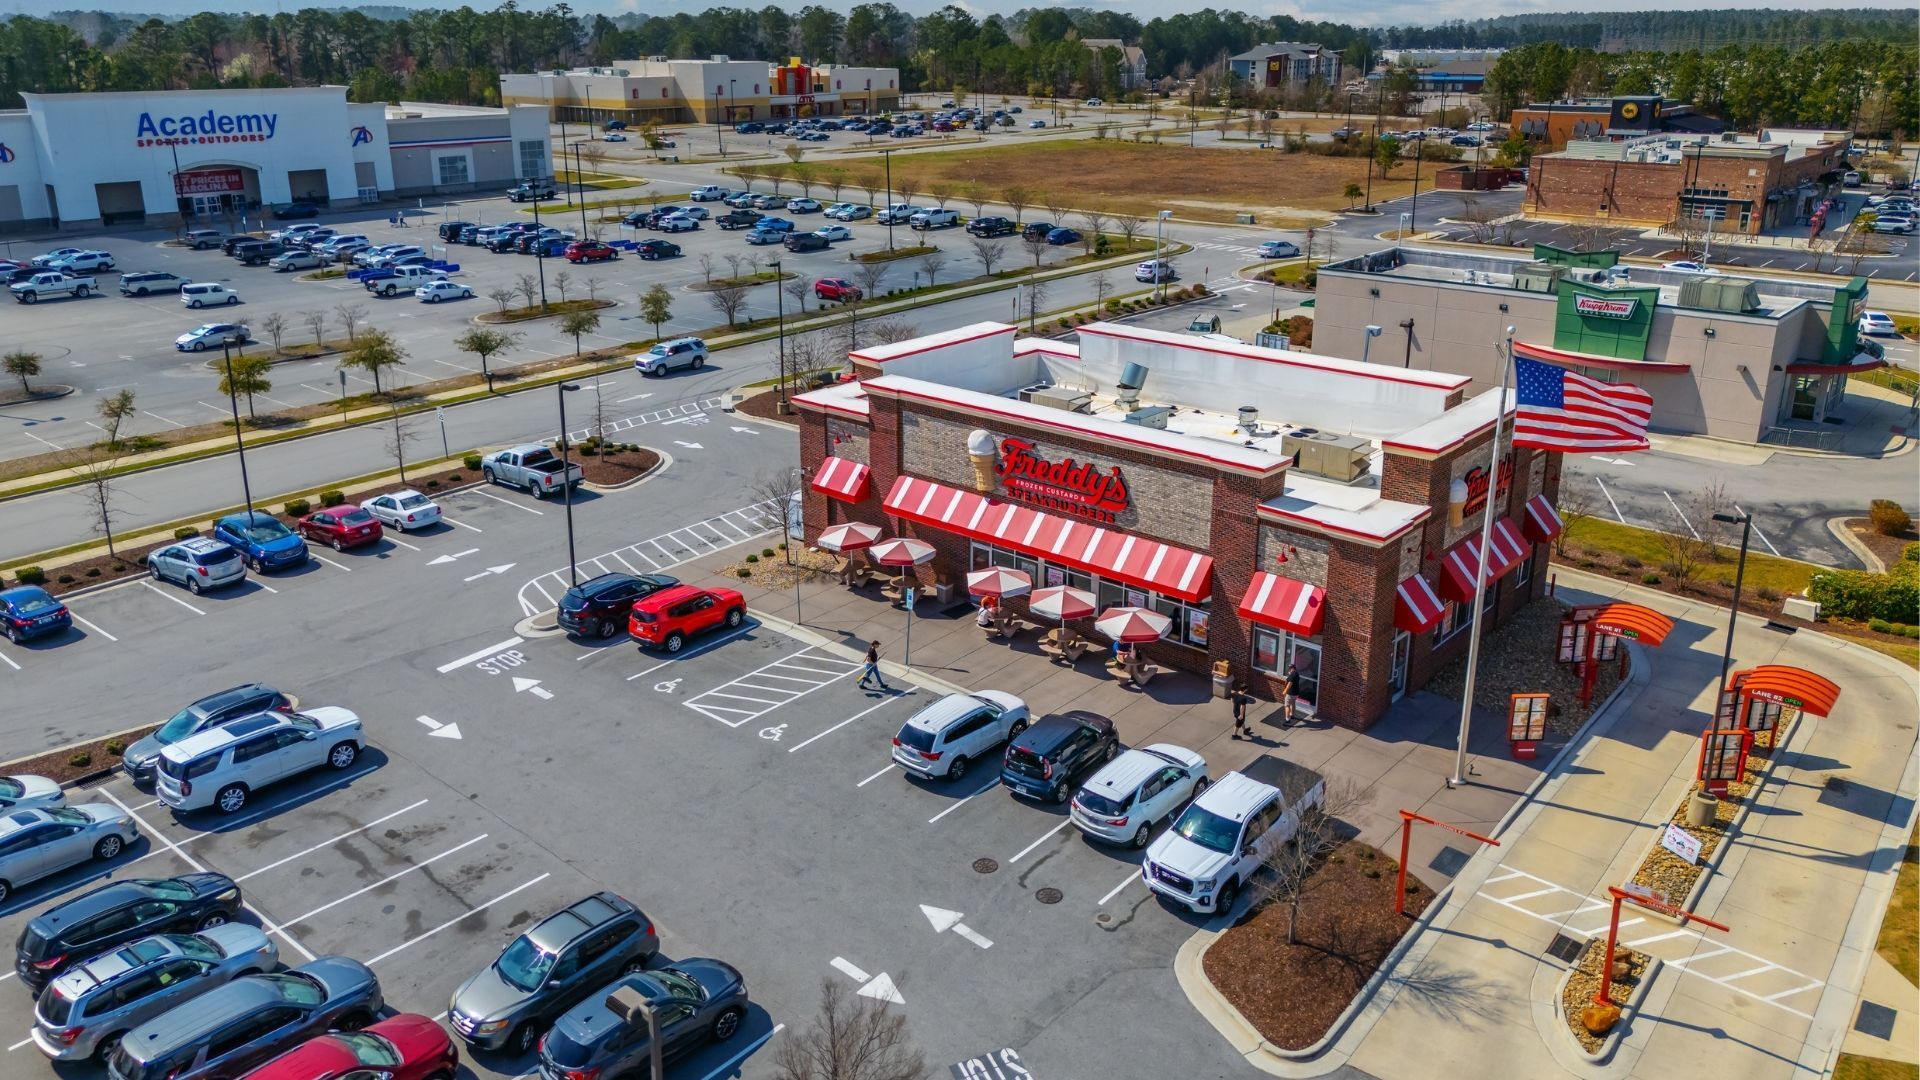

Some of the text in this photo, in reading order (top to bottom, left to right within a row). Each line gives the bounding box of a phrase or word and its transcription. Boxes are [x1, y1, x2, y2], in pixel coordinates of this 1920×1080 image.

[137, 109, 277, 139] Academy
[176, 182, 230, 194] CAROLINA
[191, 175, 226, 185] PRICES
[228, 174, 240, 182] IN
[994, 438, 1130, 512] Freddy's
[1016, 479, 1044, 491] FROZEN
[1046, 487, 1079, 500] CUSTARD
[1007, 487, 1115, 523] STEAKBURGERS
[1595, 623, 1613, 632] LANE
[1623, 629, 1639, 638] OPEN
[476, 649, 527, 675] STOP
[1751, 689, 1772, 699] LANE
[1784, 698, 1802, 706] OPEN
